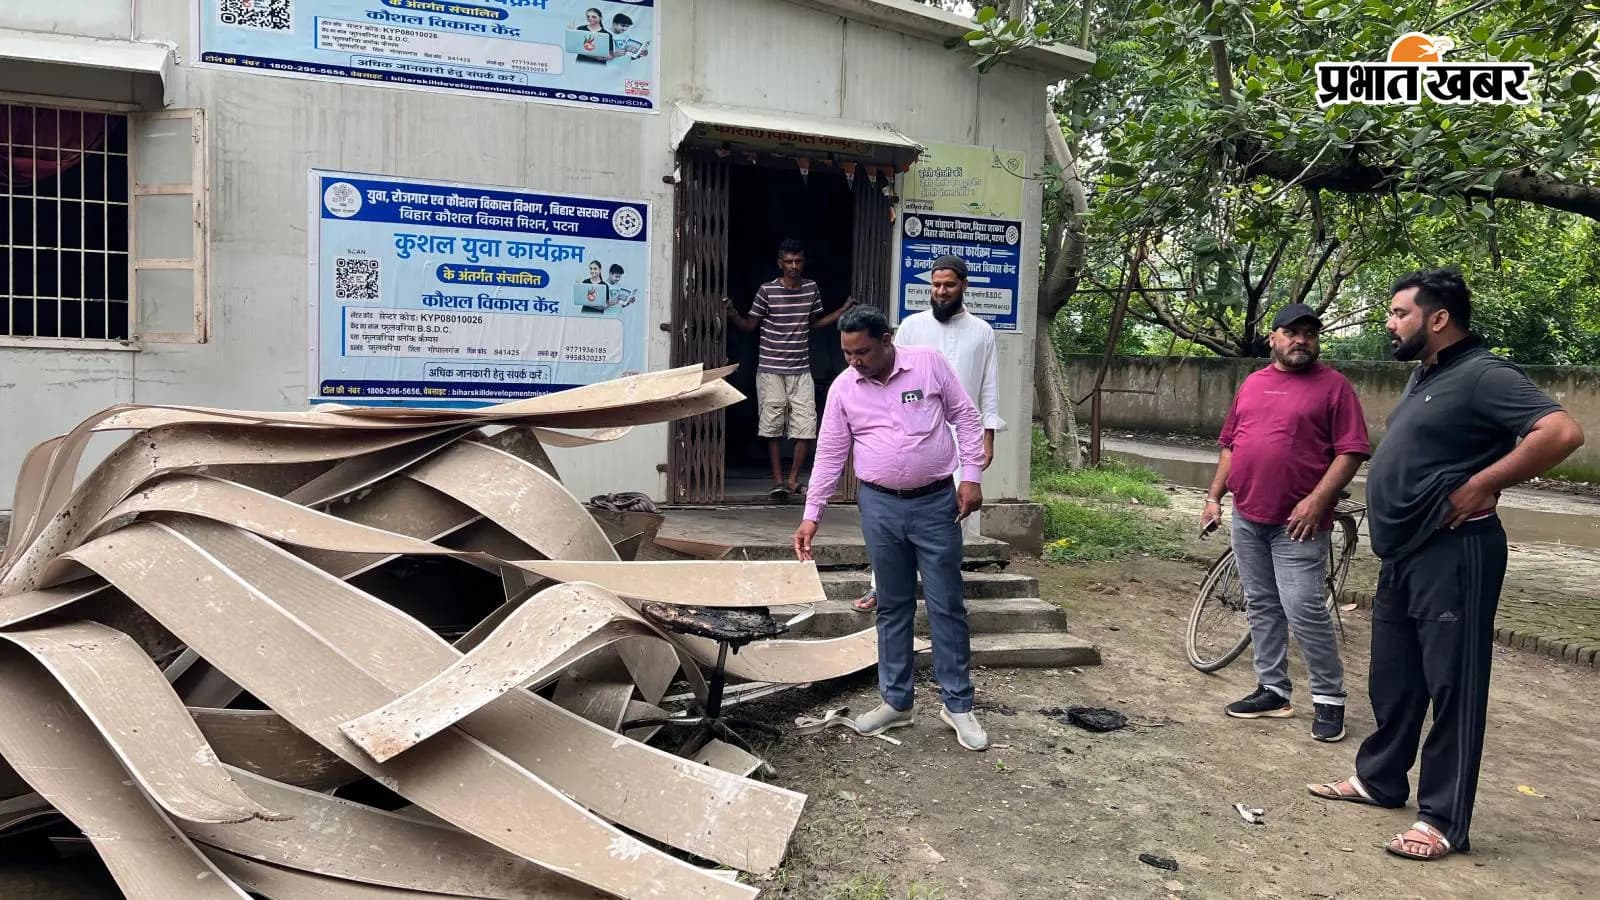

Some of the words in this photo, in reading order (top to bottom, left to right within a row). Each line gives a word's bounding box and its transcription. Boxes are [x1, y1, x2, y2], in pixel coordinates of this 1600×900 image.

[366, 9, 424, 25] कौशल
[428, 15, 486, 33] विकास
[491, 22, 520, 38] केंद्र
[447, 4, 499, 18] संचालित
[357, 58, 393, 69] अधिक
[396, 61, 444, 75] जानकारी
[447, 68, 463, 78] हेतु
[467, 70, 495, 80] संपर्क
[391, 74, 548, 98] biharskilldevelopmentmission.in
[602, 97, 648, 108] BiharSDM
[367, 189, 390, 205] युवा,
[391, 188, 429, 206] रोजगार
[446, 192, 478, 210] कौशल
[480, 195, 512, 212] विकास
[549, 201, 577, 217] बिहार
[576, 206, 610, 220] सरकार
[399, 205, 432, 222] बिहार
[434, 209, 473, 225] कौशल
[476, 211, 513, 228] विकास
[516, 215, 549, 232] मिशन,
[552, 219, 580, 233] पटना
[393, 232, 457, 260] कुशल
[461, 236, 502, 264] युवा
[506, 237, 587, 264] कार्यक्रम
[442, 266, 455, 280] के
[458, 267, 493, 284] अंतर्गत
[496, 270, 542, 286] संचालित
[421, 289, 473, 309] कौशल
[477, 293, 530, 312] विकास
[533, 295, 561, 314] केंद्र
[420, 313, 484, 325] KYP08010026
[428, 366, 454, 378] अधिक
[456, 367, 491, 379] जानकारी
[493, 368, 505, 381] हेतु
[506, 369, 528, 380] संपर्क
[529, 370, 543, 381] करें
